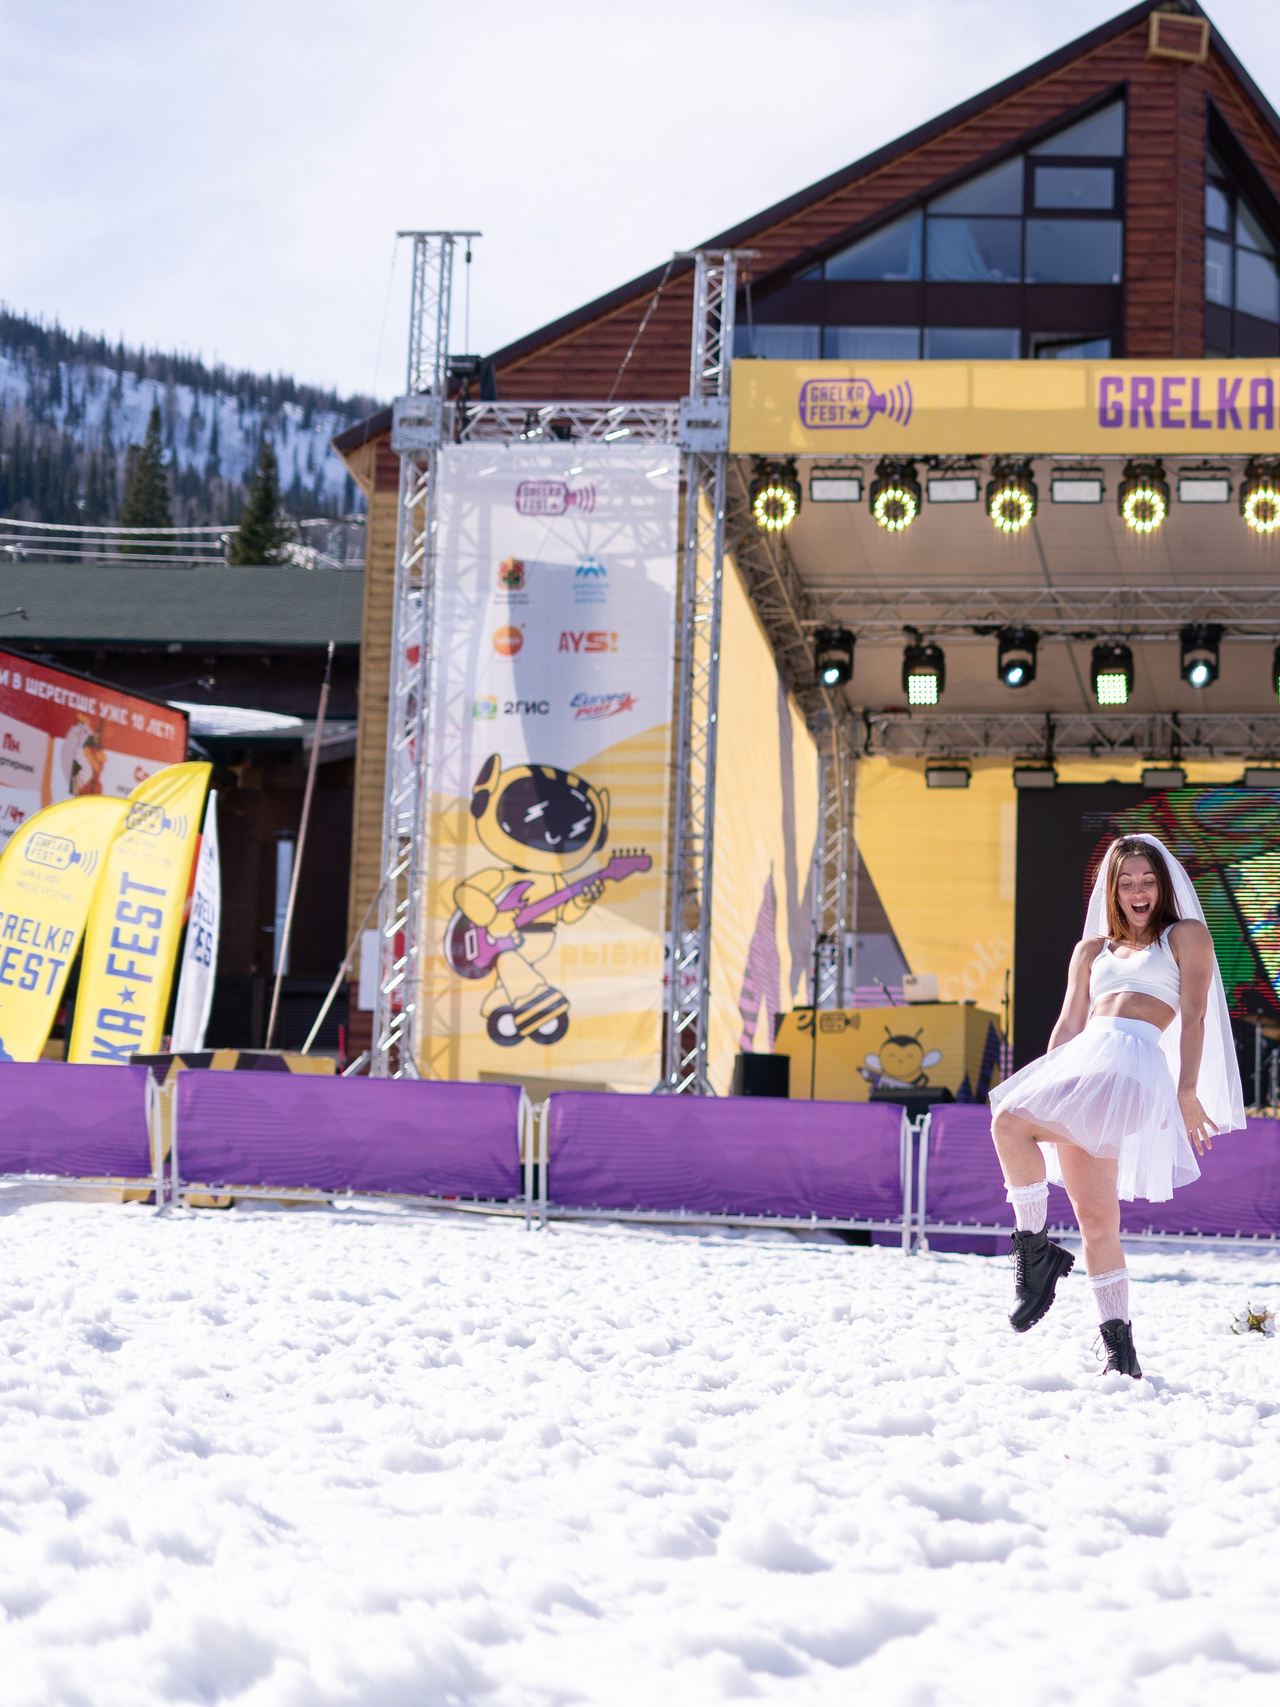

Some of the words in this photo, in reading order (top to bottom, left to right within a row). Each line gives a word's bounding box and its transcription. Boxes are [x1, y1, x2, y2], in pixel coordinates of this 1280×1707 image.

[810, 386, 864, 402] GRELKA
[810, 405, 845, 421] FEST
[558, 630, 618, 653] AYS!
[13, 672, 22, 691] В
[25, 677, 97, 716] ШЕРЕГЕШЕ
[100, 702, 128, 727] УЖЕ
[131, 712, 144, 732] 10
[146, 717, 175, 741] ЛЕТ!
[504, 699, 550, 716] 2ГИС
[3, 733, 20, 753] Пн
[0, 912, 75, 955] RELKA
[0, 944, 66, 996] EST
